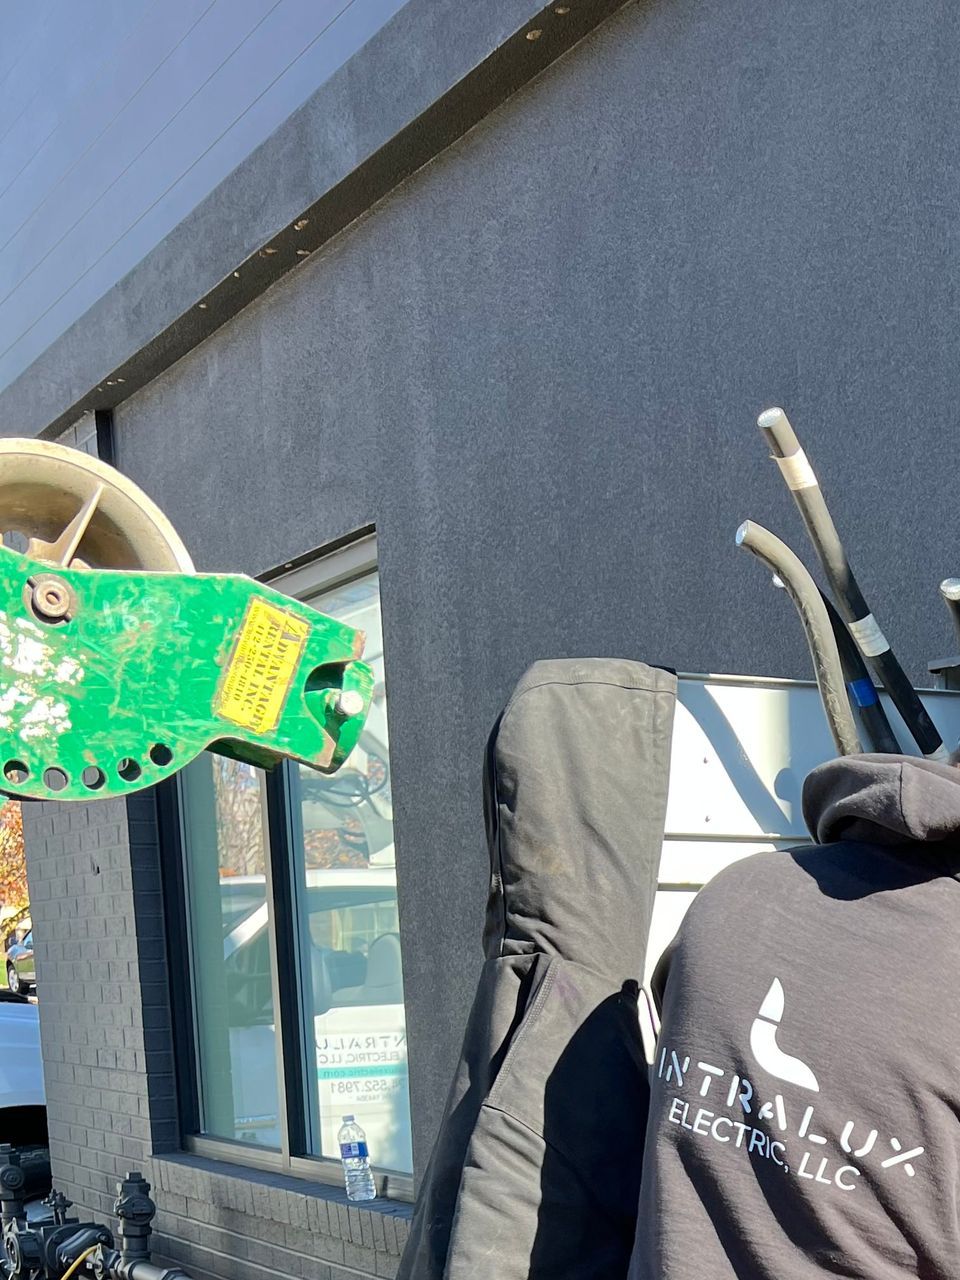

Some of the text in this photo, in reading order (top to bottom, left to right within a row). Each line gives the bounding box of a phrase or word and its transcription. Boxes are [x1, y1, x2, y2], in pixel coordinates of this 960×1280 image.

[250, 620, 301, 727] ADVANTAGE
[253, 622, 282, 679] RENTAL
[240, 682, 260, 712] INC.
[659, 1047, 925, 1177] INTRALUX
[669, 1098, 861, 1190] ELECTRIC, LLC
